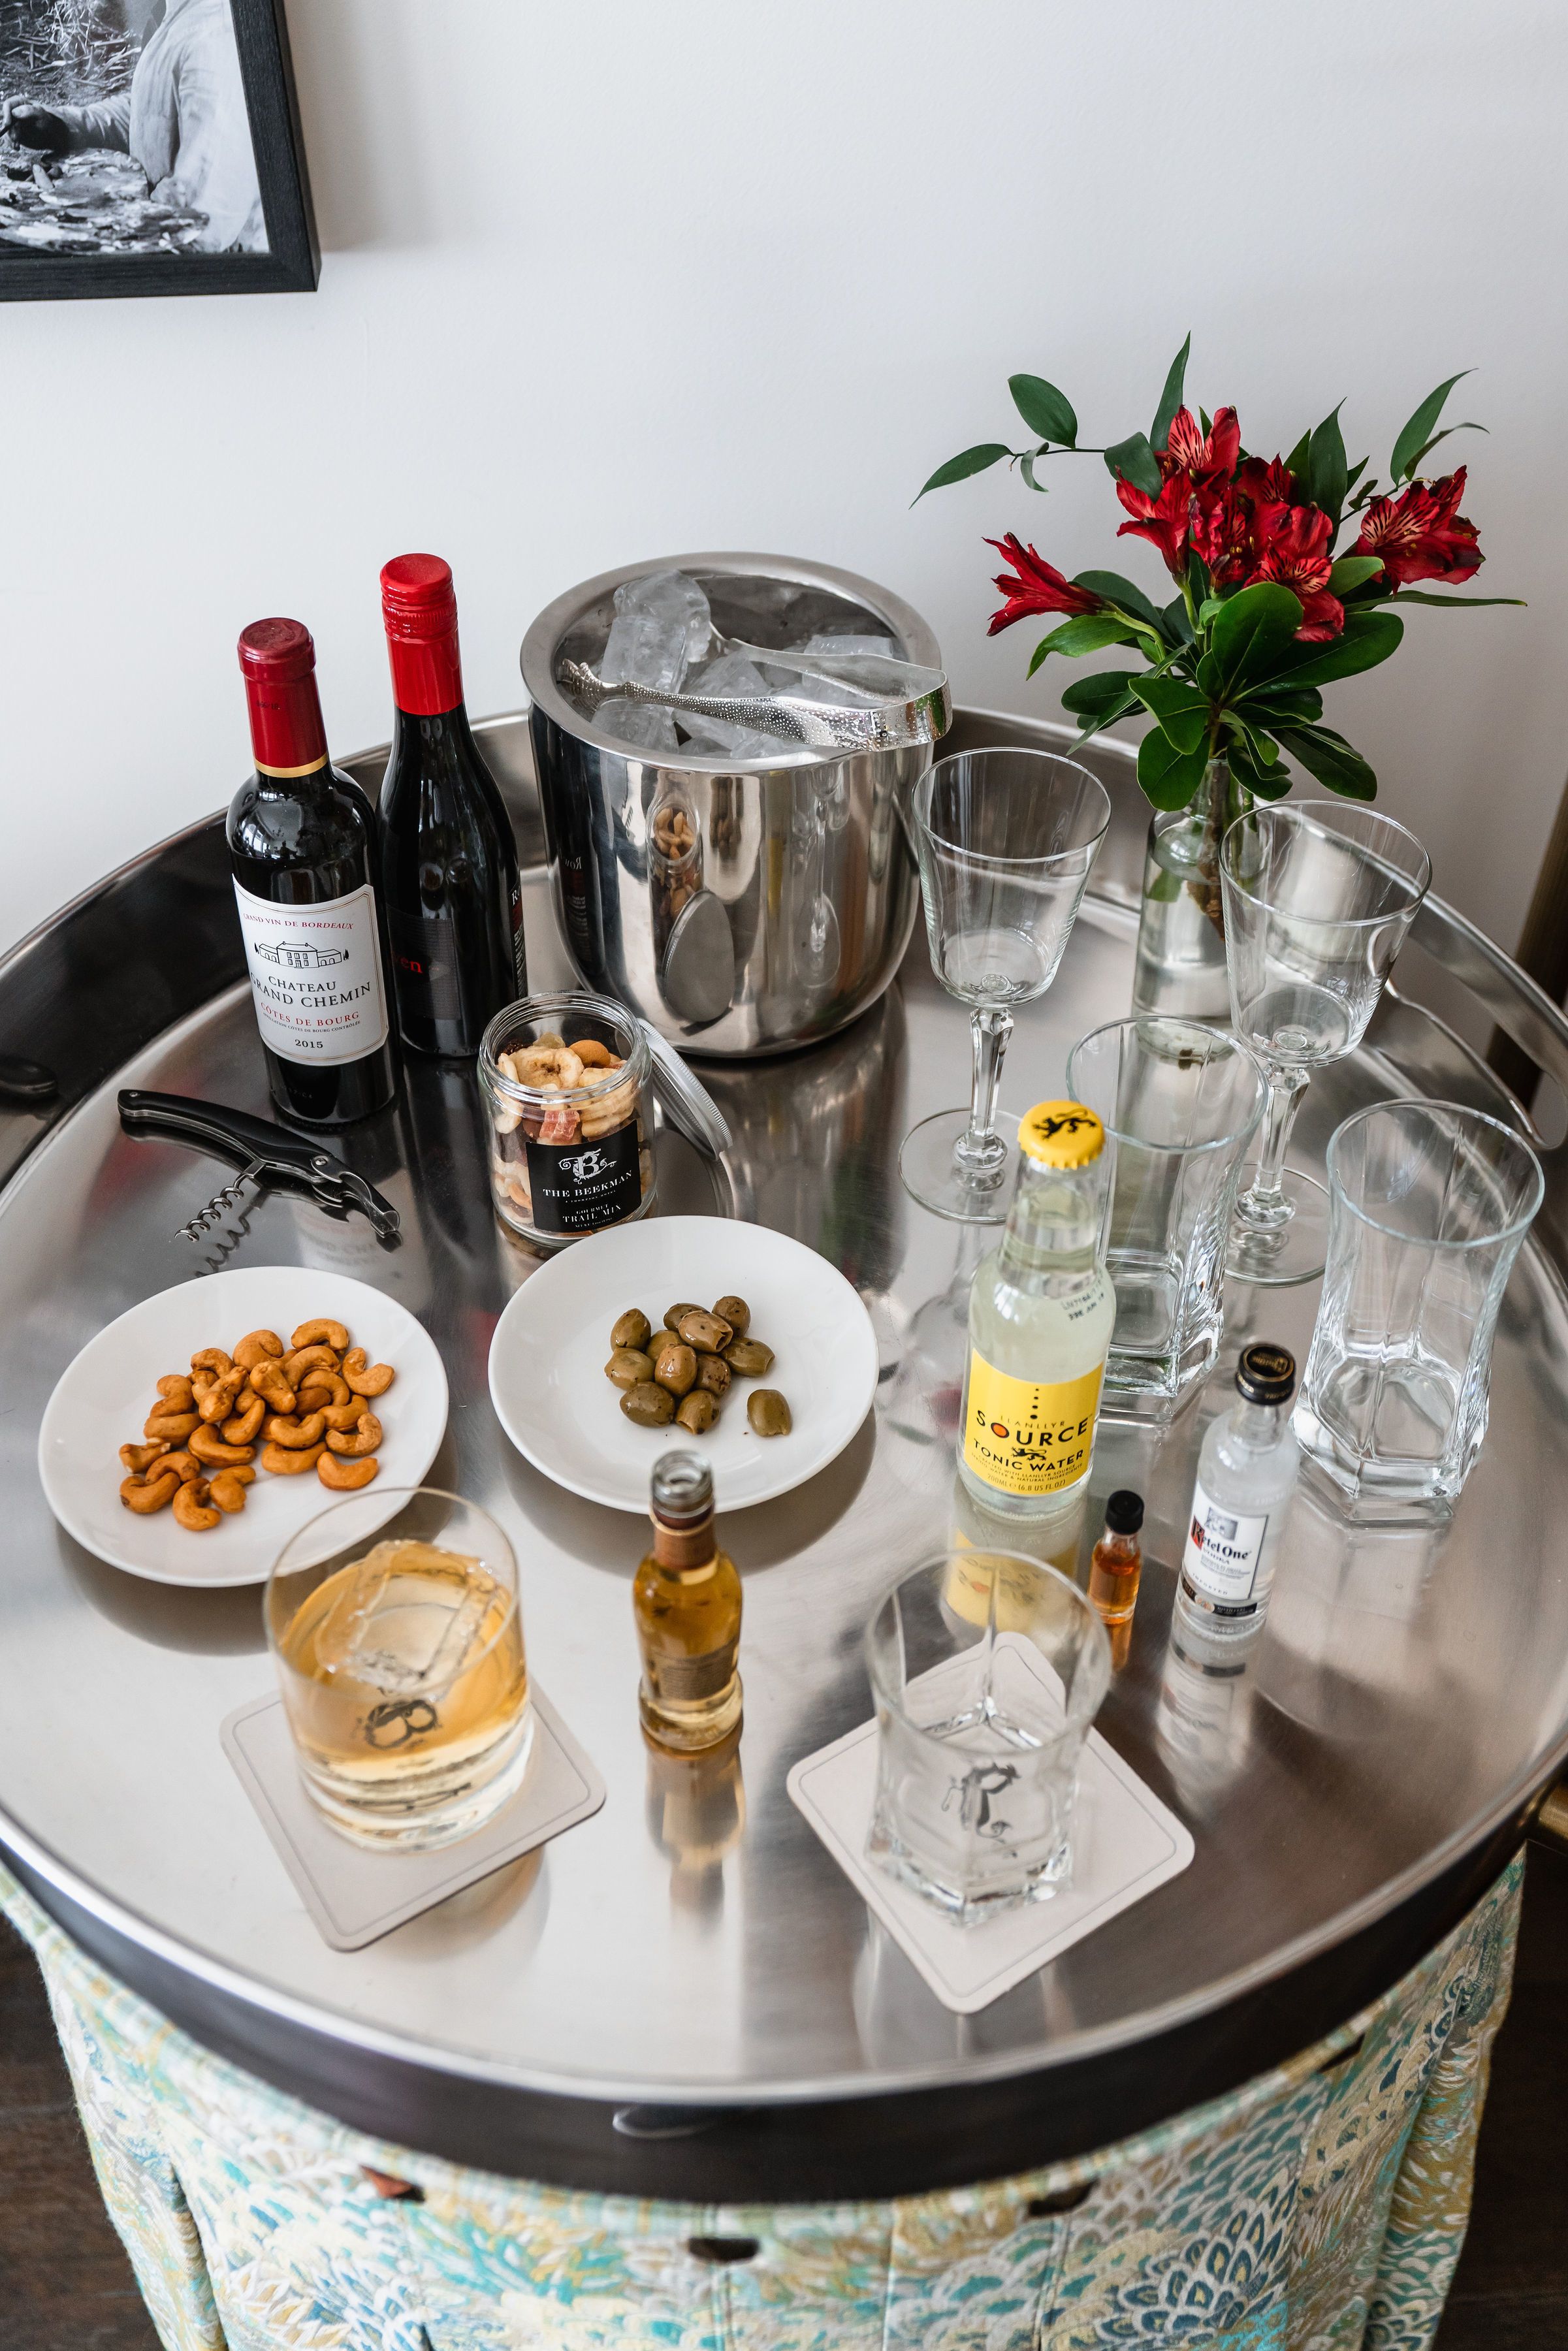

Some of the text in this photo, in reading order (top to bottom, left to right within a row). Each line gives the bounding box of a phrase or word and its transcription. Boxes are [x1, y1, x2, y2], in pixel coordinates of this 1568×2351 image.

[243, 912, 264, 923] GRAND
[302, 921, 354, 930] BORDEAUX
[250, 971, 294, 1005] GRAND
[300, 981, 371, 1008] CHEMIN
[268, 975, 336, 993] CHATEAU
[261, 1001, 359, 1027] CÔTES DE BOURG
[263, 1012, 287, 1028] APPELLATION
[295, 1038, 323, 1049] 2015
[542, 1170, 632, 1197] THE BEEKMAN
[562, 1212, 598, 1223] TRAIL
[602, 1204, 622, 1216] MIX
[576, 1203, 609, 1215] GOURMET
[976, 1409, 1089, 1447] SOURCE
[1000, 1415, 1066, 1430] LLANLLYR
[974, 1437, 1084, 1472] TONIC WATER
[989, 1467, 1008, 1478] WATER
[1047, 1462, 1083, 1482] INGREDIENTS
[1053, 1463, 1076, 1476] SOURCE
[987, 1473, 1009, 1488] 200ML
[1222, 1545, 1250, 1560] One
